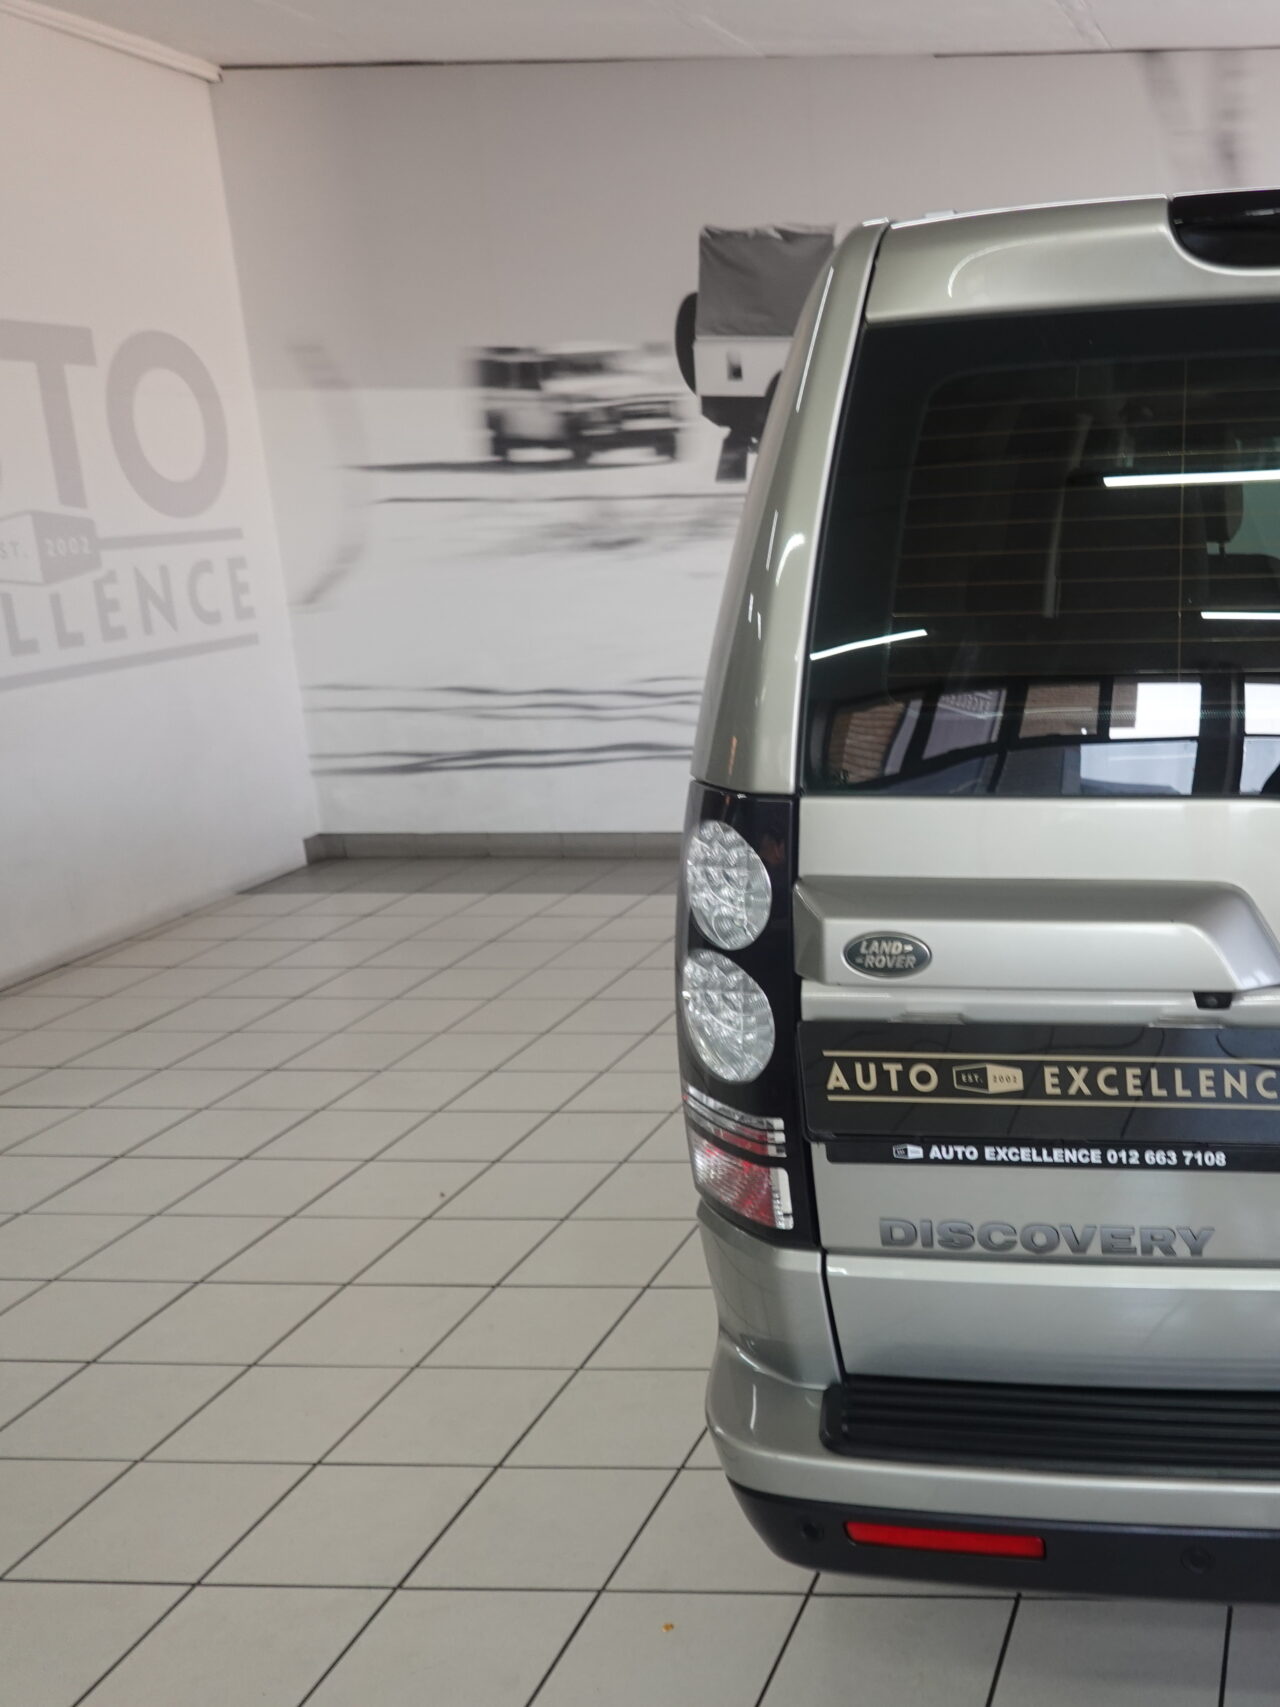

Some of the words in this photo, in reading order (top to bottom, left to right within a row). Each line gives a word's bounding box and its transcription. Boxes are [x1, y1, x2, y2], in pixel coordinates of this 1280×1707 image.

[0, 556, 257, 657] LLENCE
[860, 940, 903, 956] LAND
[864, 955, 917, 969] ROVER
[826, 1061, 939, 1092] AUTO
[929, 1145, 979, 1161] AUTO
[985, 1146, 1102, 1164] EXCELLENCE
[1107, 1149, 1140, 1165] 012
[1145, 1151, 1178, 1166] 663
[1183, 1151, 1227, 1167] 7108
[879, 1217, 1216, 1258] DISCOVERY
